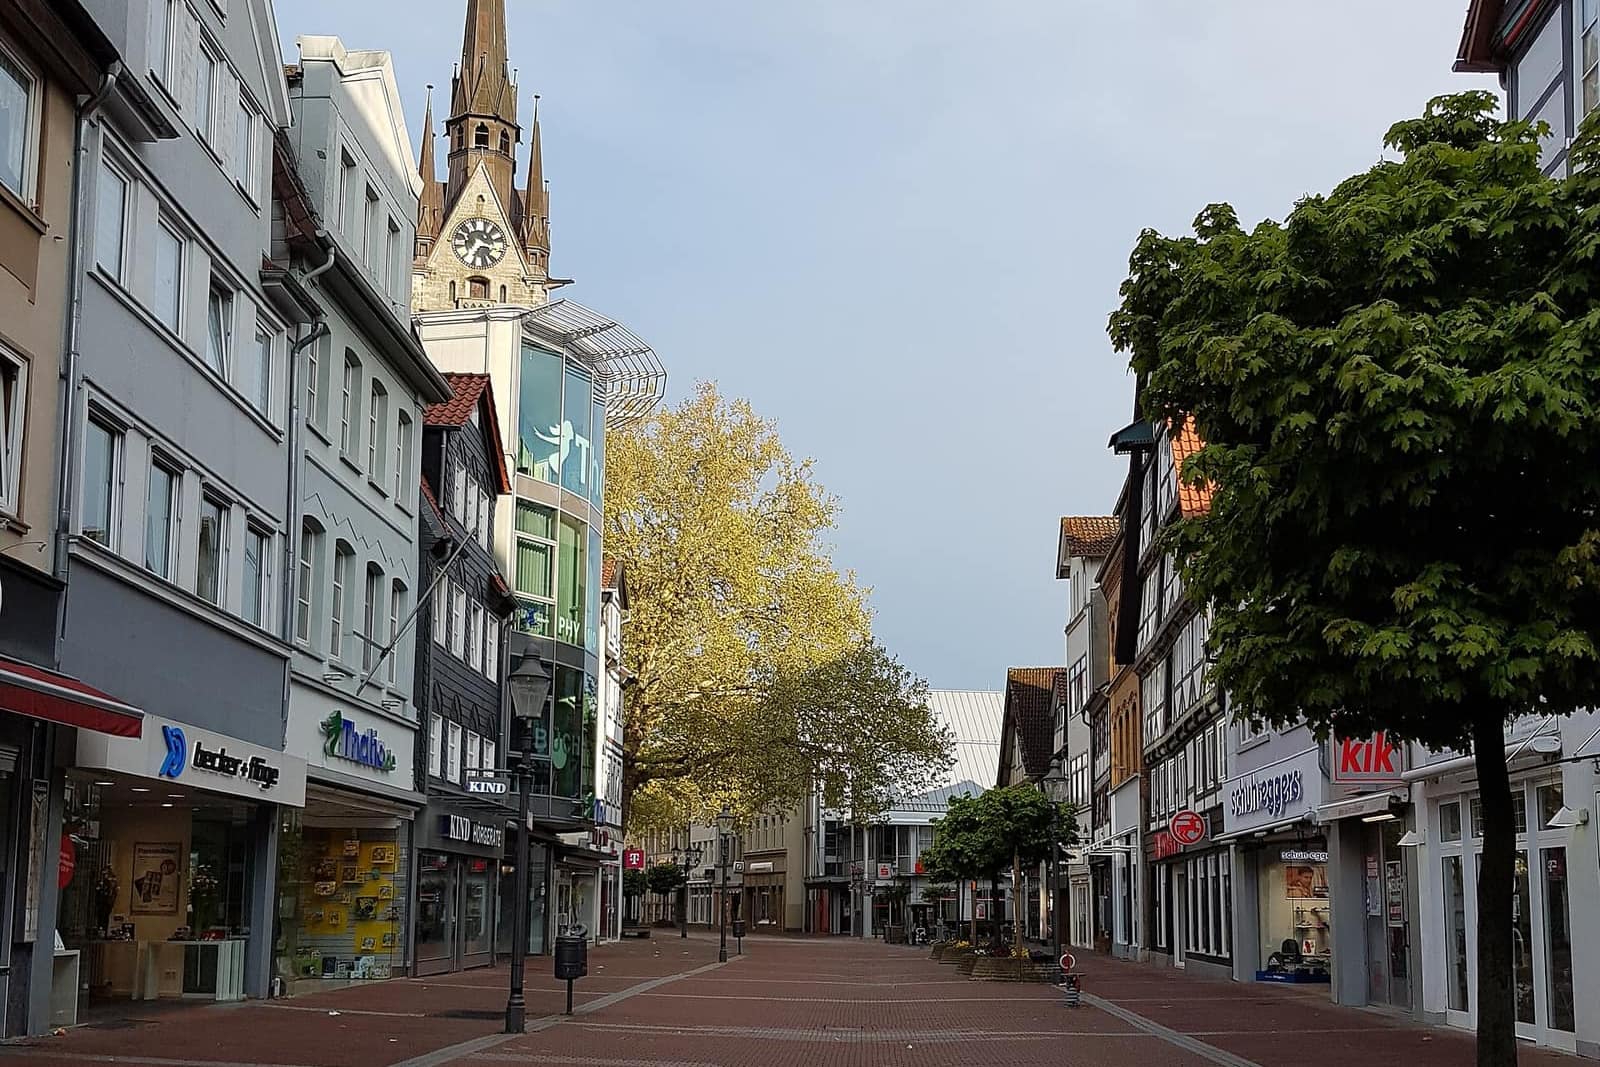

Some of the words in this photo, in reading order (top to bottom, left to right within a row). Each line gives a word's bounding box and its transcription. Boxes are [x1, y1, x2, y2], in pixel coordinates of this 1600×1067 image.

[193, 741, 241, 776] becker
[469, 781, 507, 794] KIND
[450, 814, 471, 841] KIND
